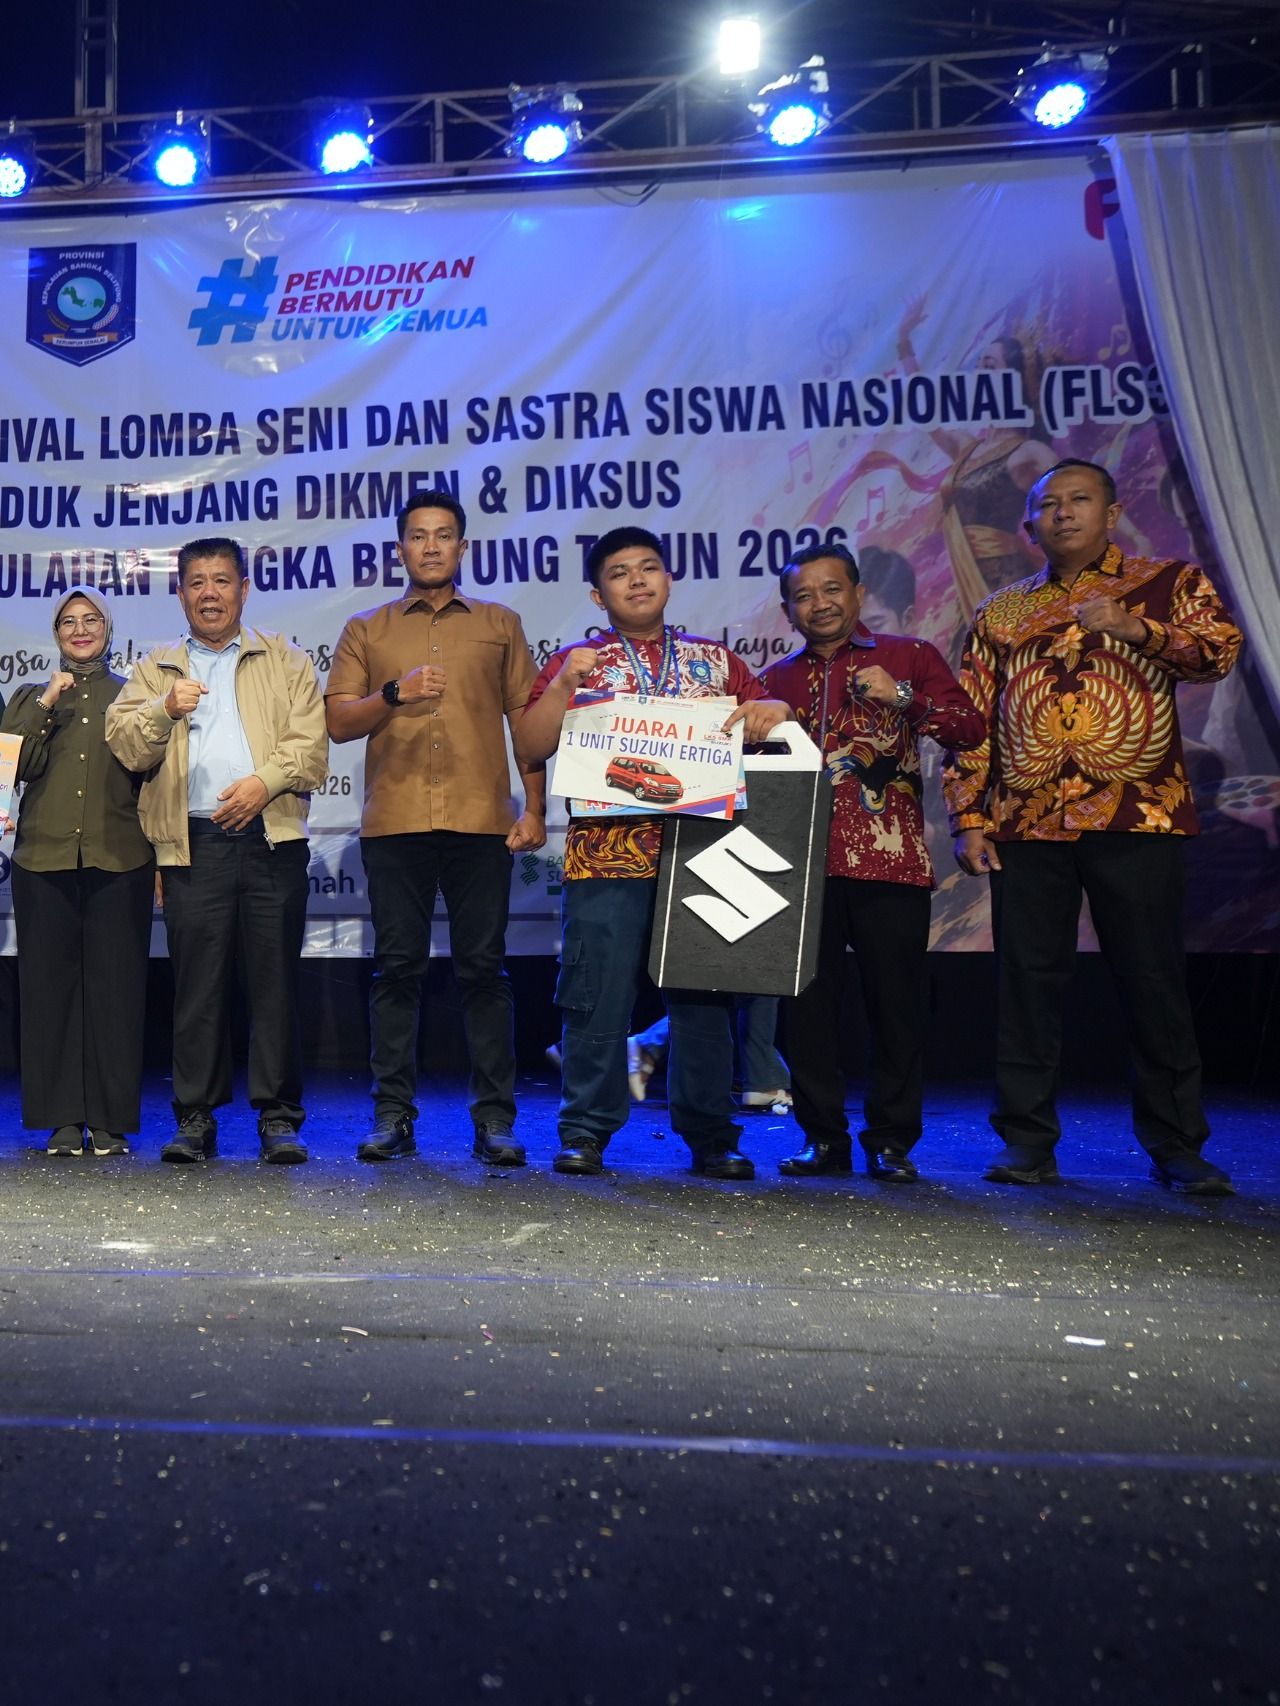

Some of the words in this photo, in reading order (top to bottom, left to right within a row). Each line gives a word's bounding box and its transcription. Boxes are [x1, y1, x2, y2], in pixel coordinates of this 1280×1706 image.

[59, 251, 105, 260] PROVINSI
[70, 262, 103, 273] BANGKA
[283, 256, 475, 294] PENDIDIKAN
[277, 288, 425, 315] BERMUTU
[271, 315, 377, 342] UNTUK
[382, 306, 488, 334] SEMUA
[99, 412, 242, 460] LOMBA
[256, 407, 349, 456] SENI
[365, 399, 449, 448] DAN
[466, 391, 631, 445] SASTRA
[645, 384, 786, 436] SISWA
[801, 373, 1026, 430] NASIONAL
[93, 477, 279, 528] JENJANG
[478, 465, 508, 514] &
[525, 459, 682, 513] DIKSUS
[352, 535, 559, 588] BEUNG
[575, 531, 720, 583] TUN
[610, 716, 679, 740] JUARA
[687, 725, 694, 741] I
[566, 731, 574, 746] 1
[579, 732, 617, 751] UNIT
[619, 737, 676, 759] SUZUKI
[679, 744, 733, 766] ERTIGA
[311, 775, 351, 796] 026
